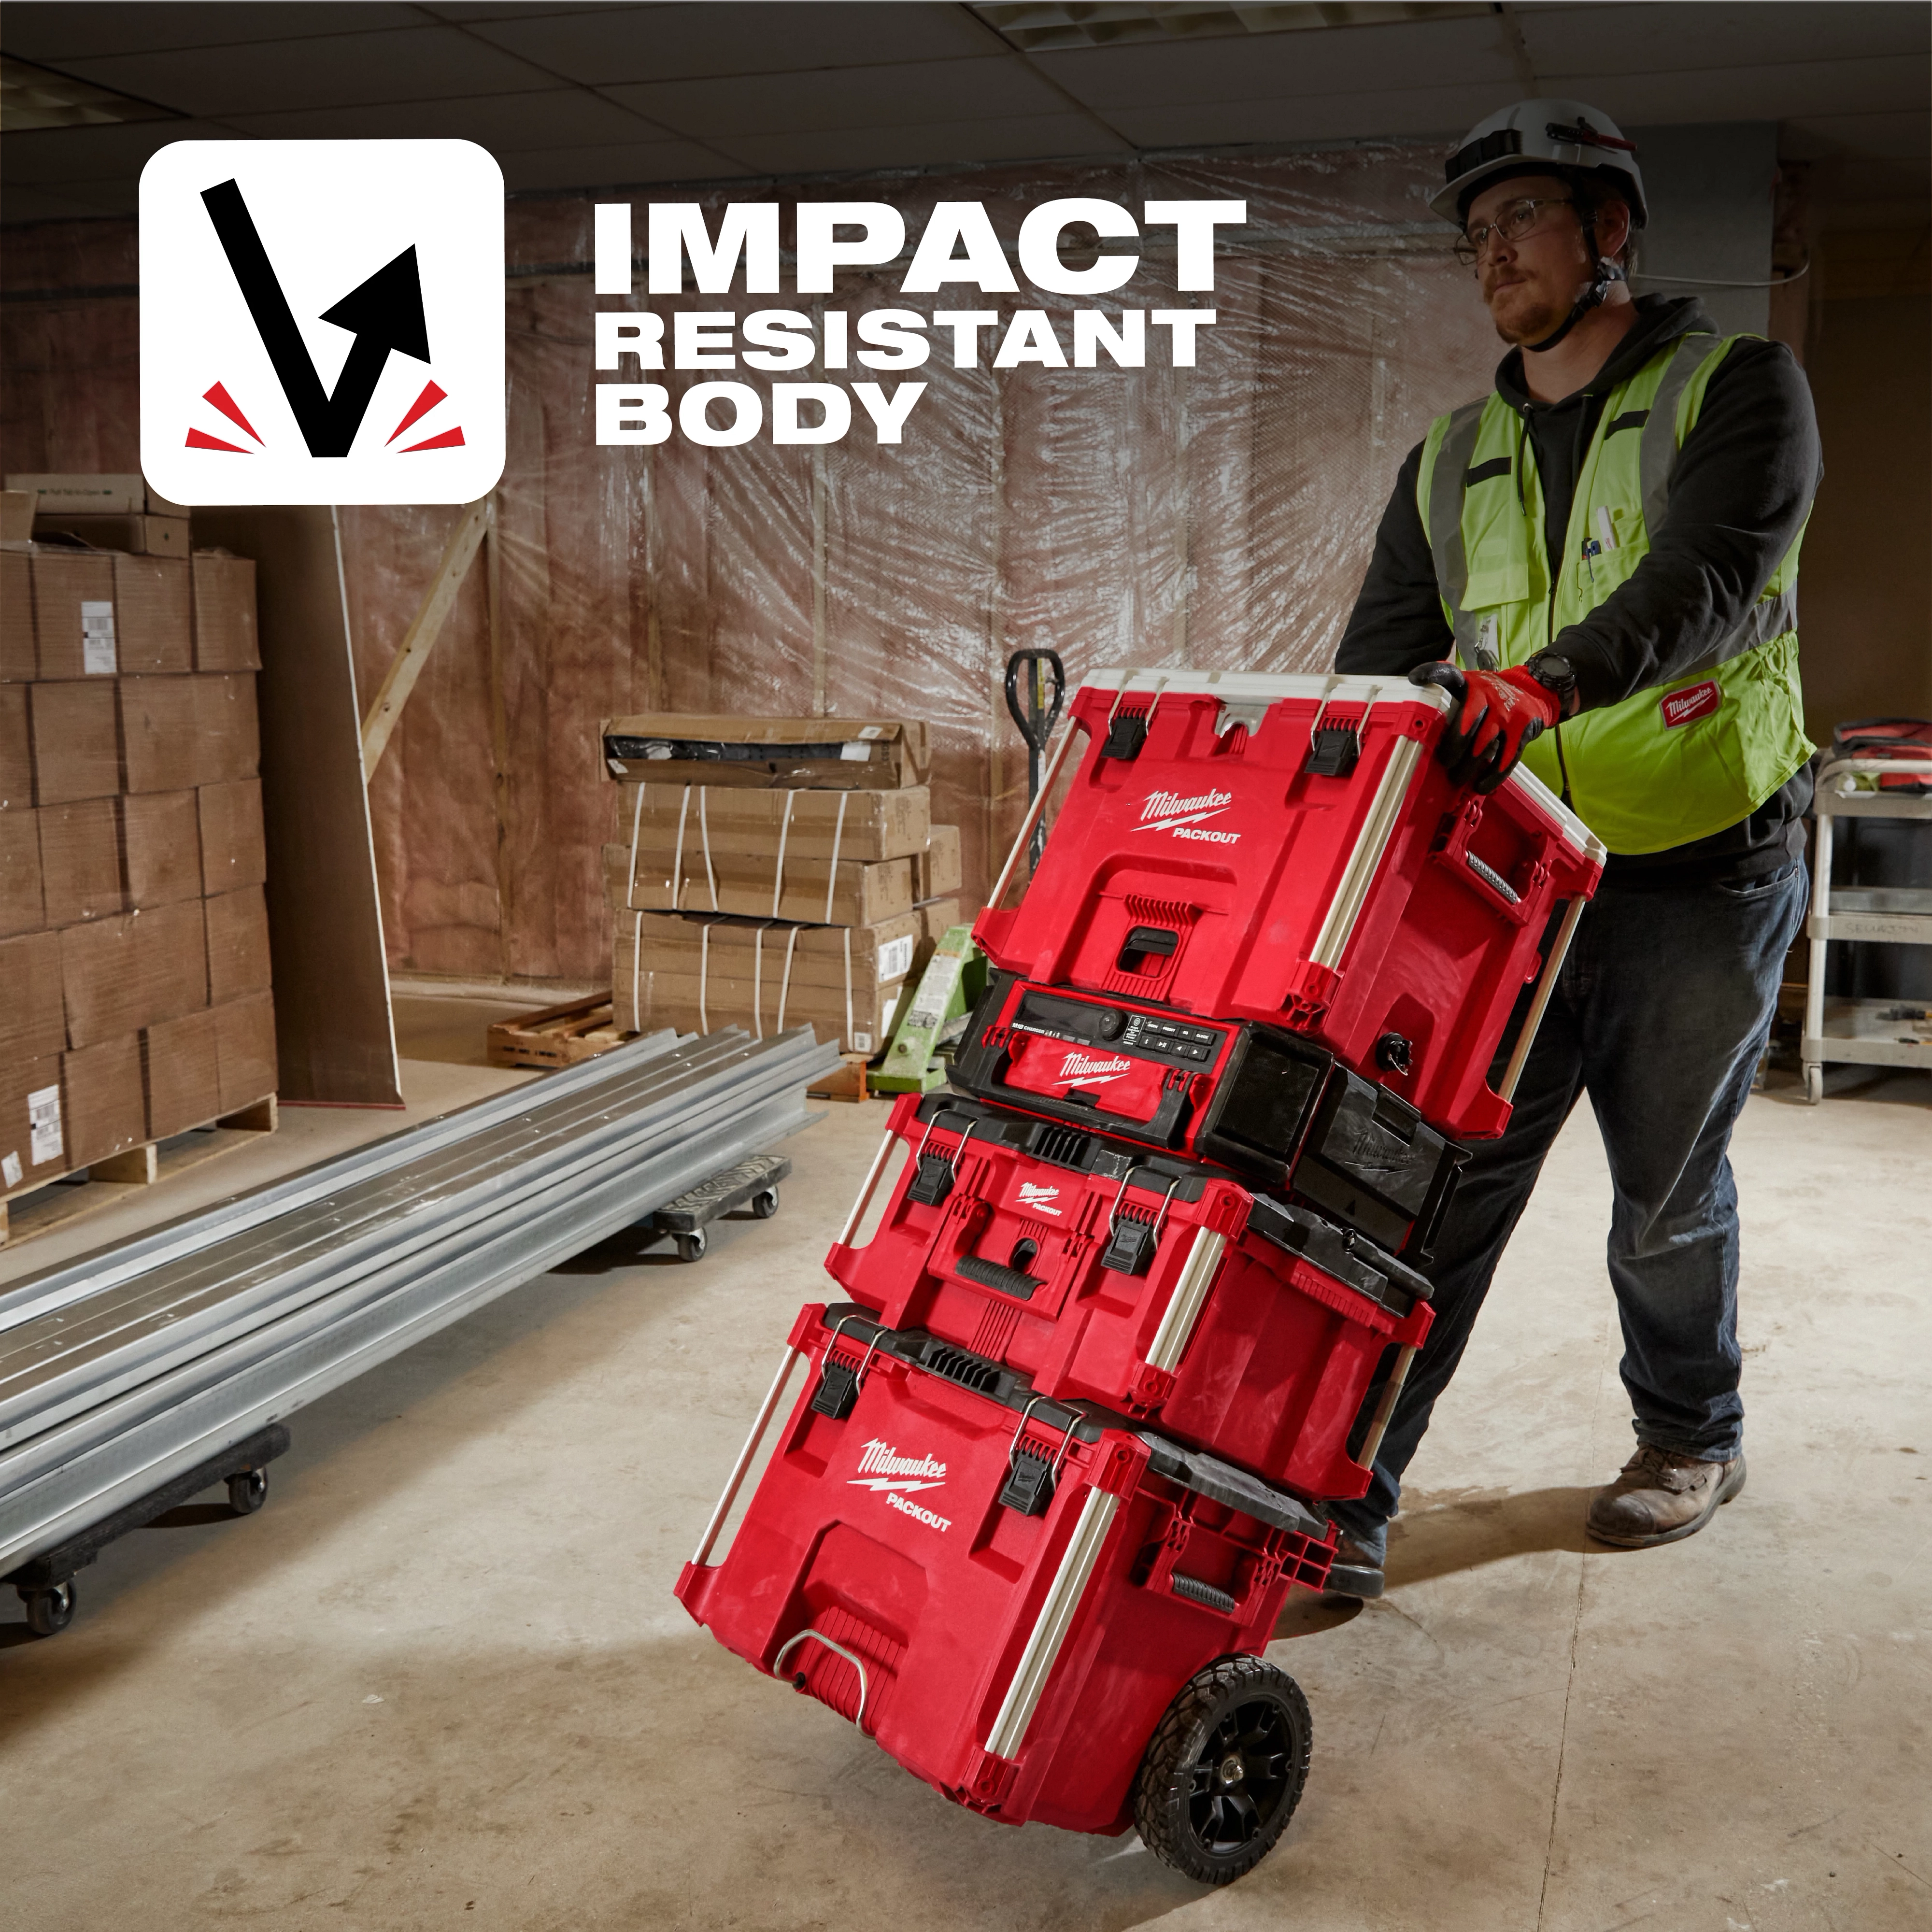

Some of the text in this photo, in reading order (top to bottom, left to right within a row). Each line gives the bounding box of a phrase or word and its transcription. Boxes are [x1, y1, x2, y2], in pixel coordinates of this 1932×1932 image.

[1665, 687, 1713, 717] Milwaukee
[1140, 788, 1231, 821] Milwaukee
[1173, 827, 1241, 844] PACKOUT
[1024, 1025, 1045, 1034] CHARGER
[1059, 1051, 1131, 1078] Milwaukee
[1019, 1181, 1059, 1197] Milwaukee
[1032, 1202, 1062, 1217] PACKOUT
[857, 1437, 946, 1478] Milwaukee
[886, 1492, 952, 1532] PACKOUT
